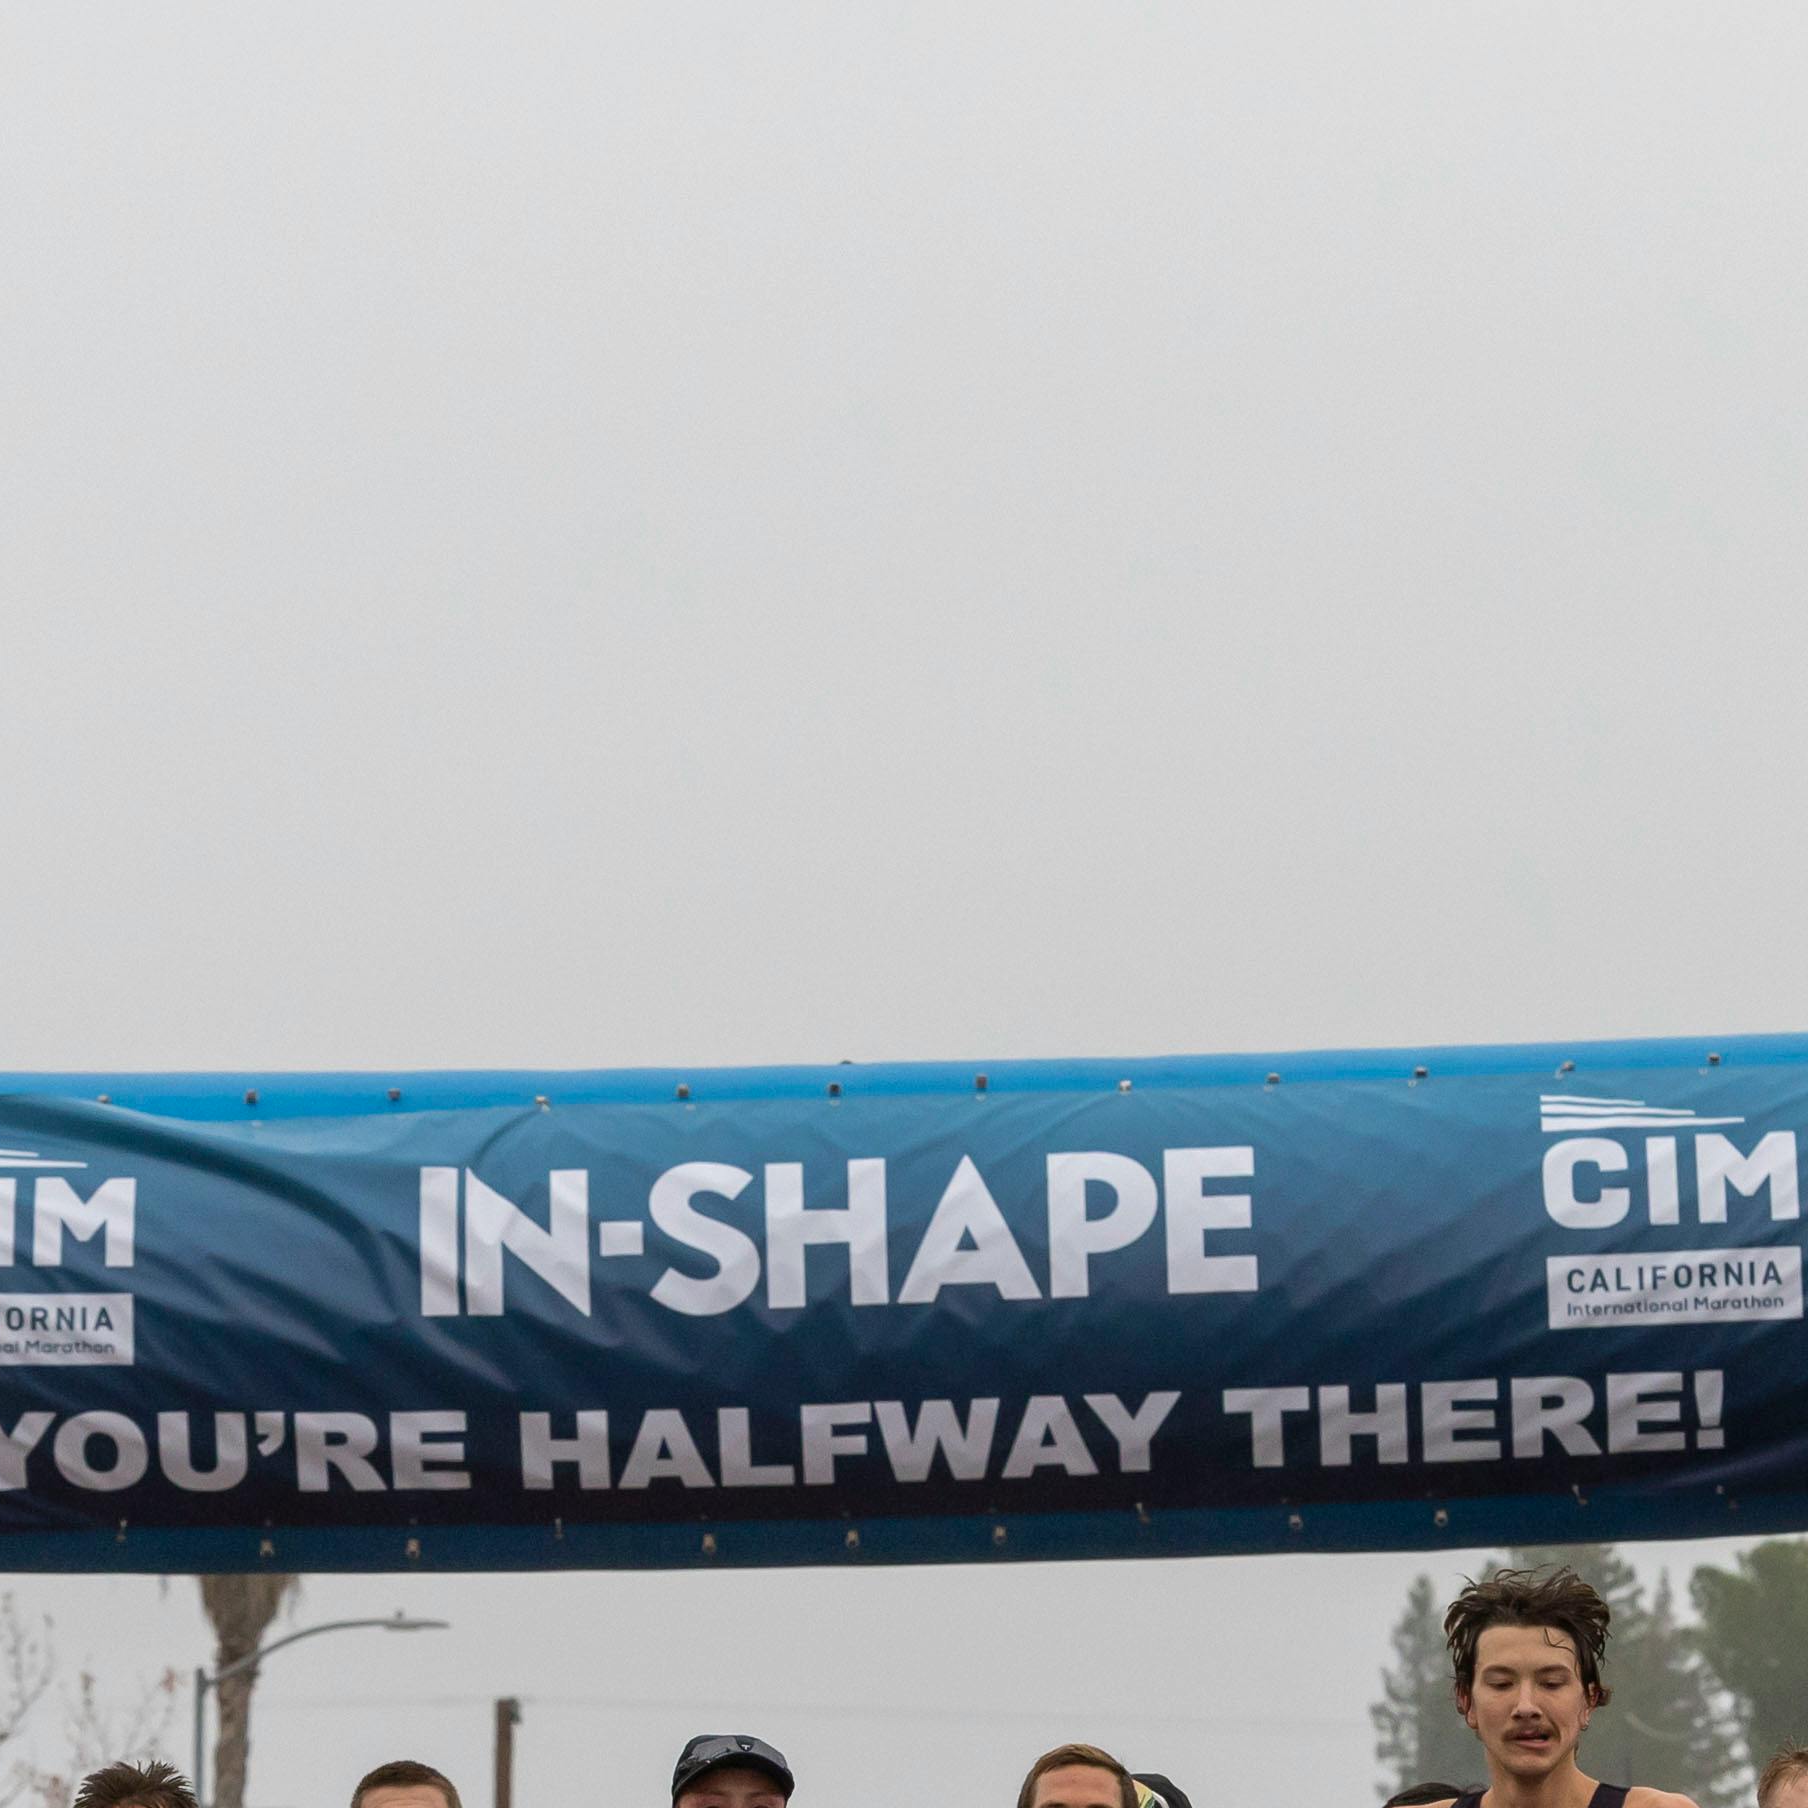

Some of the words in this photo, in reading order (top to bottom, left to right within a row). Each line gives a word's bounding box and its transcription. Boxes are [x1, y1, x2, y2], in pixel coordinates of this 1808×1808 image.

[1543, 1130, 1800, 1229] CIM
[419, 1147, 1258, 1316] IN-SHAPE
[1567, 1261, 1782, 1294] CALIFORNIA
[1567, 1299, 1689, 1317] International
[1694, 1295, 1784, 1312] Marathon
[25, 1340, 115, 1354] Marathon
[519, 1391, 1181, 1490] HALFWAY
[1223, 1370, 1725, 1468] THERE!
